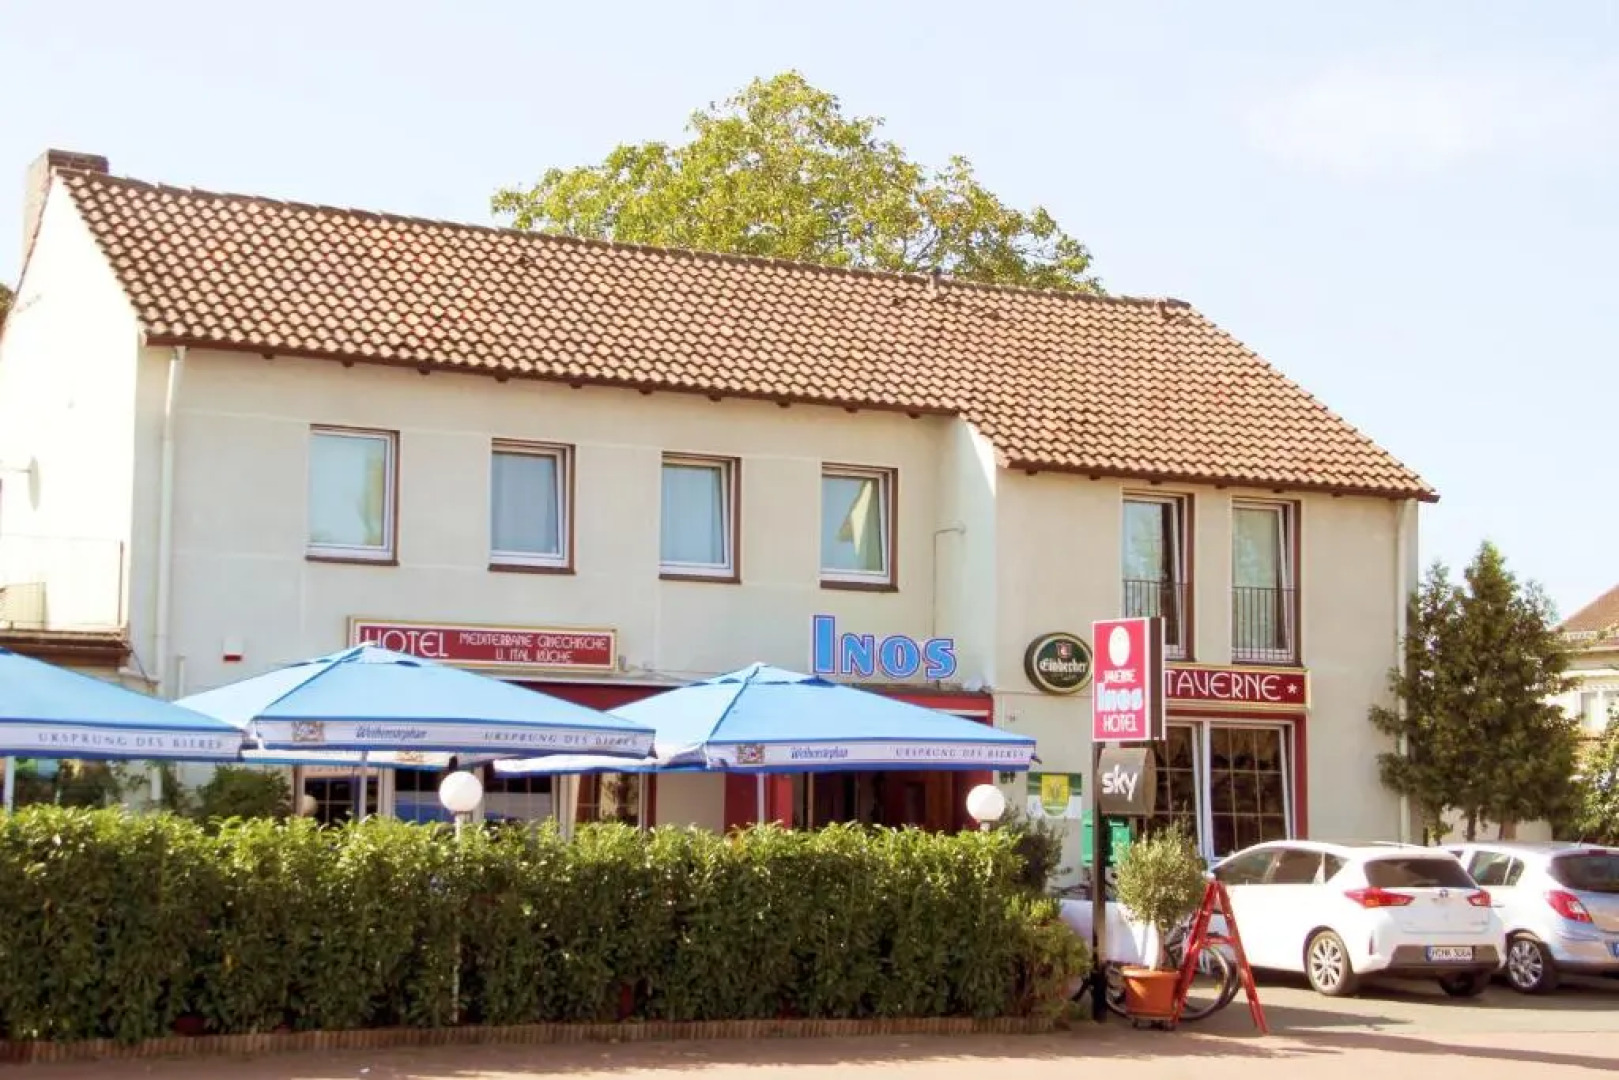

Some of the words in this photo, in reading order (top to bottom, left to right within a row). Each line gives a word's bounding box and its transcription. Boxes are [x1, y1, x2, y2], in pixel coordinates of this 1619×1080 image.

[364, 628, 449, 658] HOTEL
[813, 614, 957, 679] Inos
[1165, 670, 1281, 701] TAVERNE
[1101, 764, 1138, 802] sky
